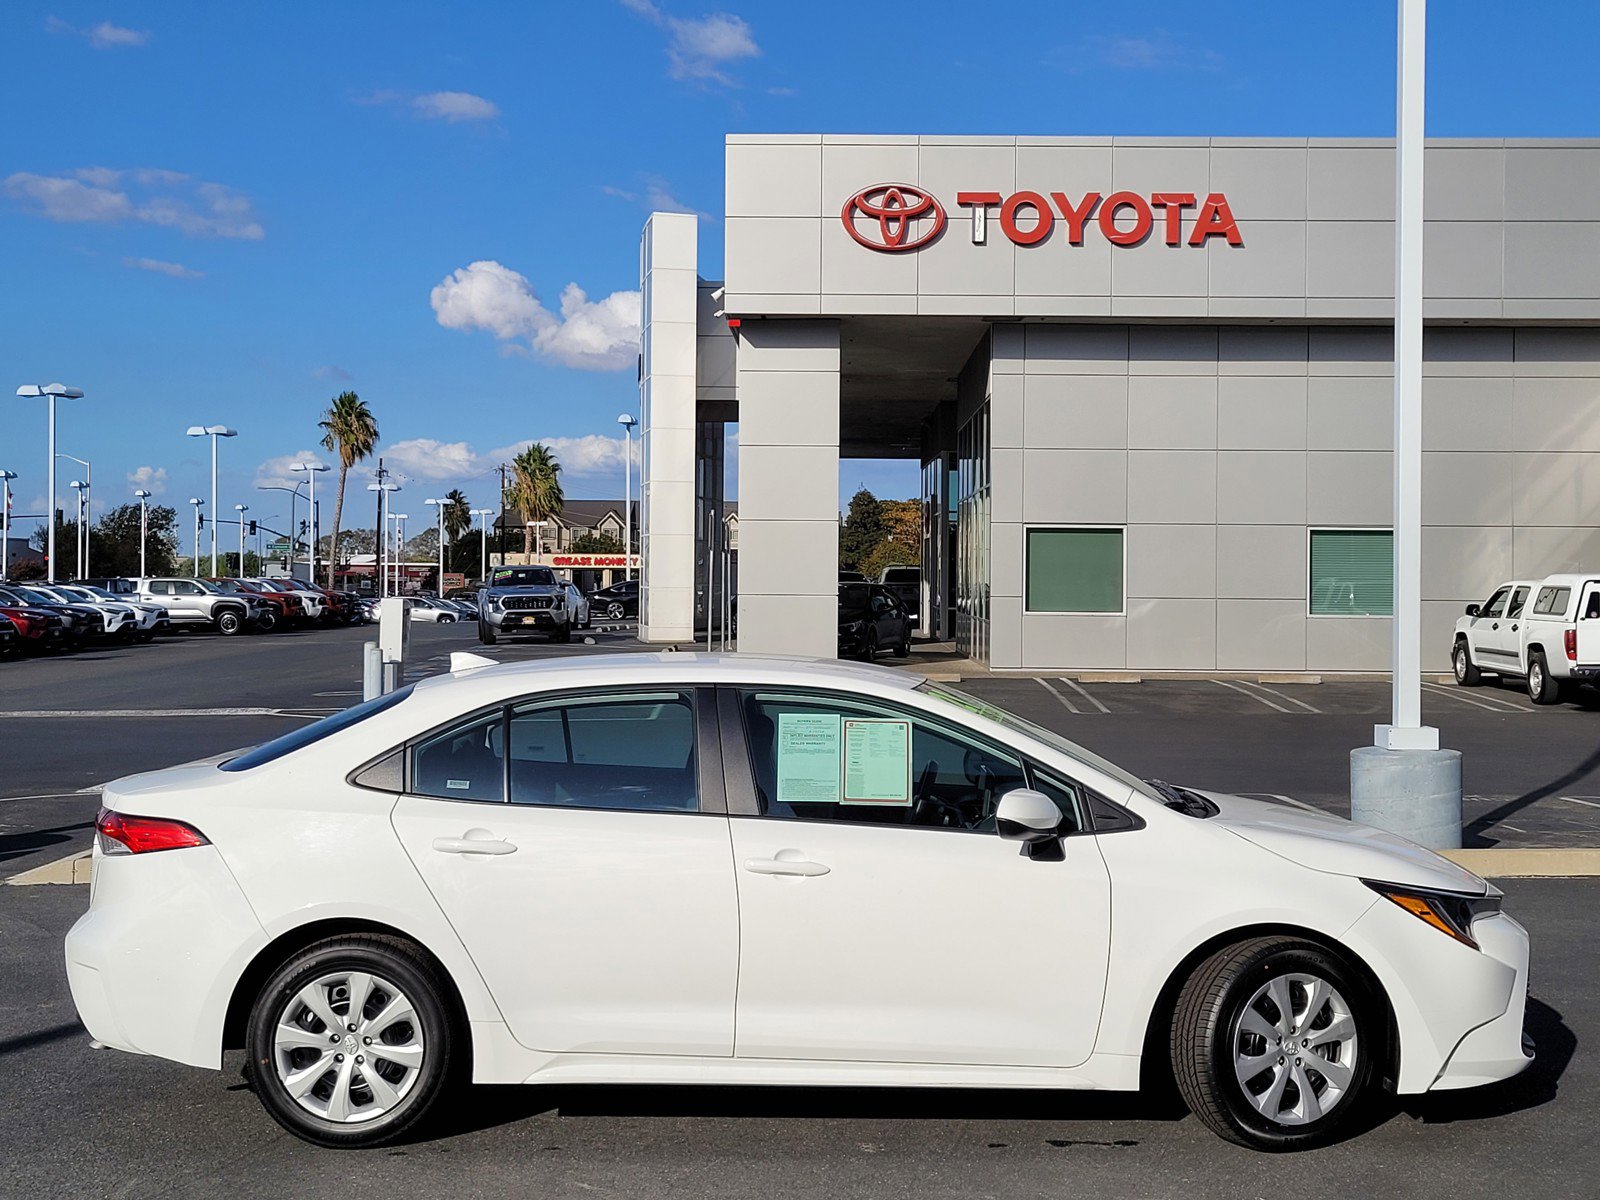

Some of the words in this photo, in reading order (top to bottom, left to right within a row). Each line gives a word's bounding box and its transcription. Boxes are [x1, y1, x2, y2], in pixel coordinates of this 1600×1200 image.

[957, 191, 1243, 246] TOYOTA
[552, 556, 592, 566] GREASE
[594, 557, 638, 566] MONKY
